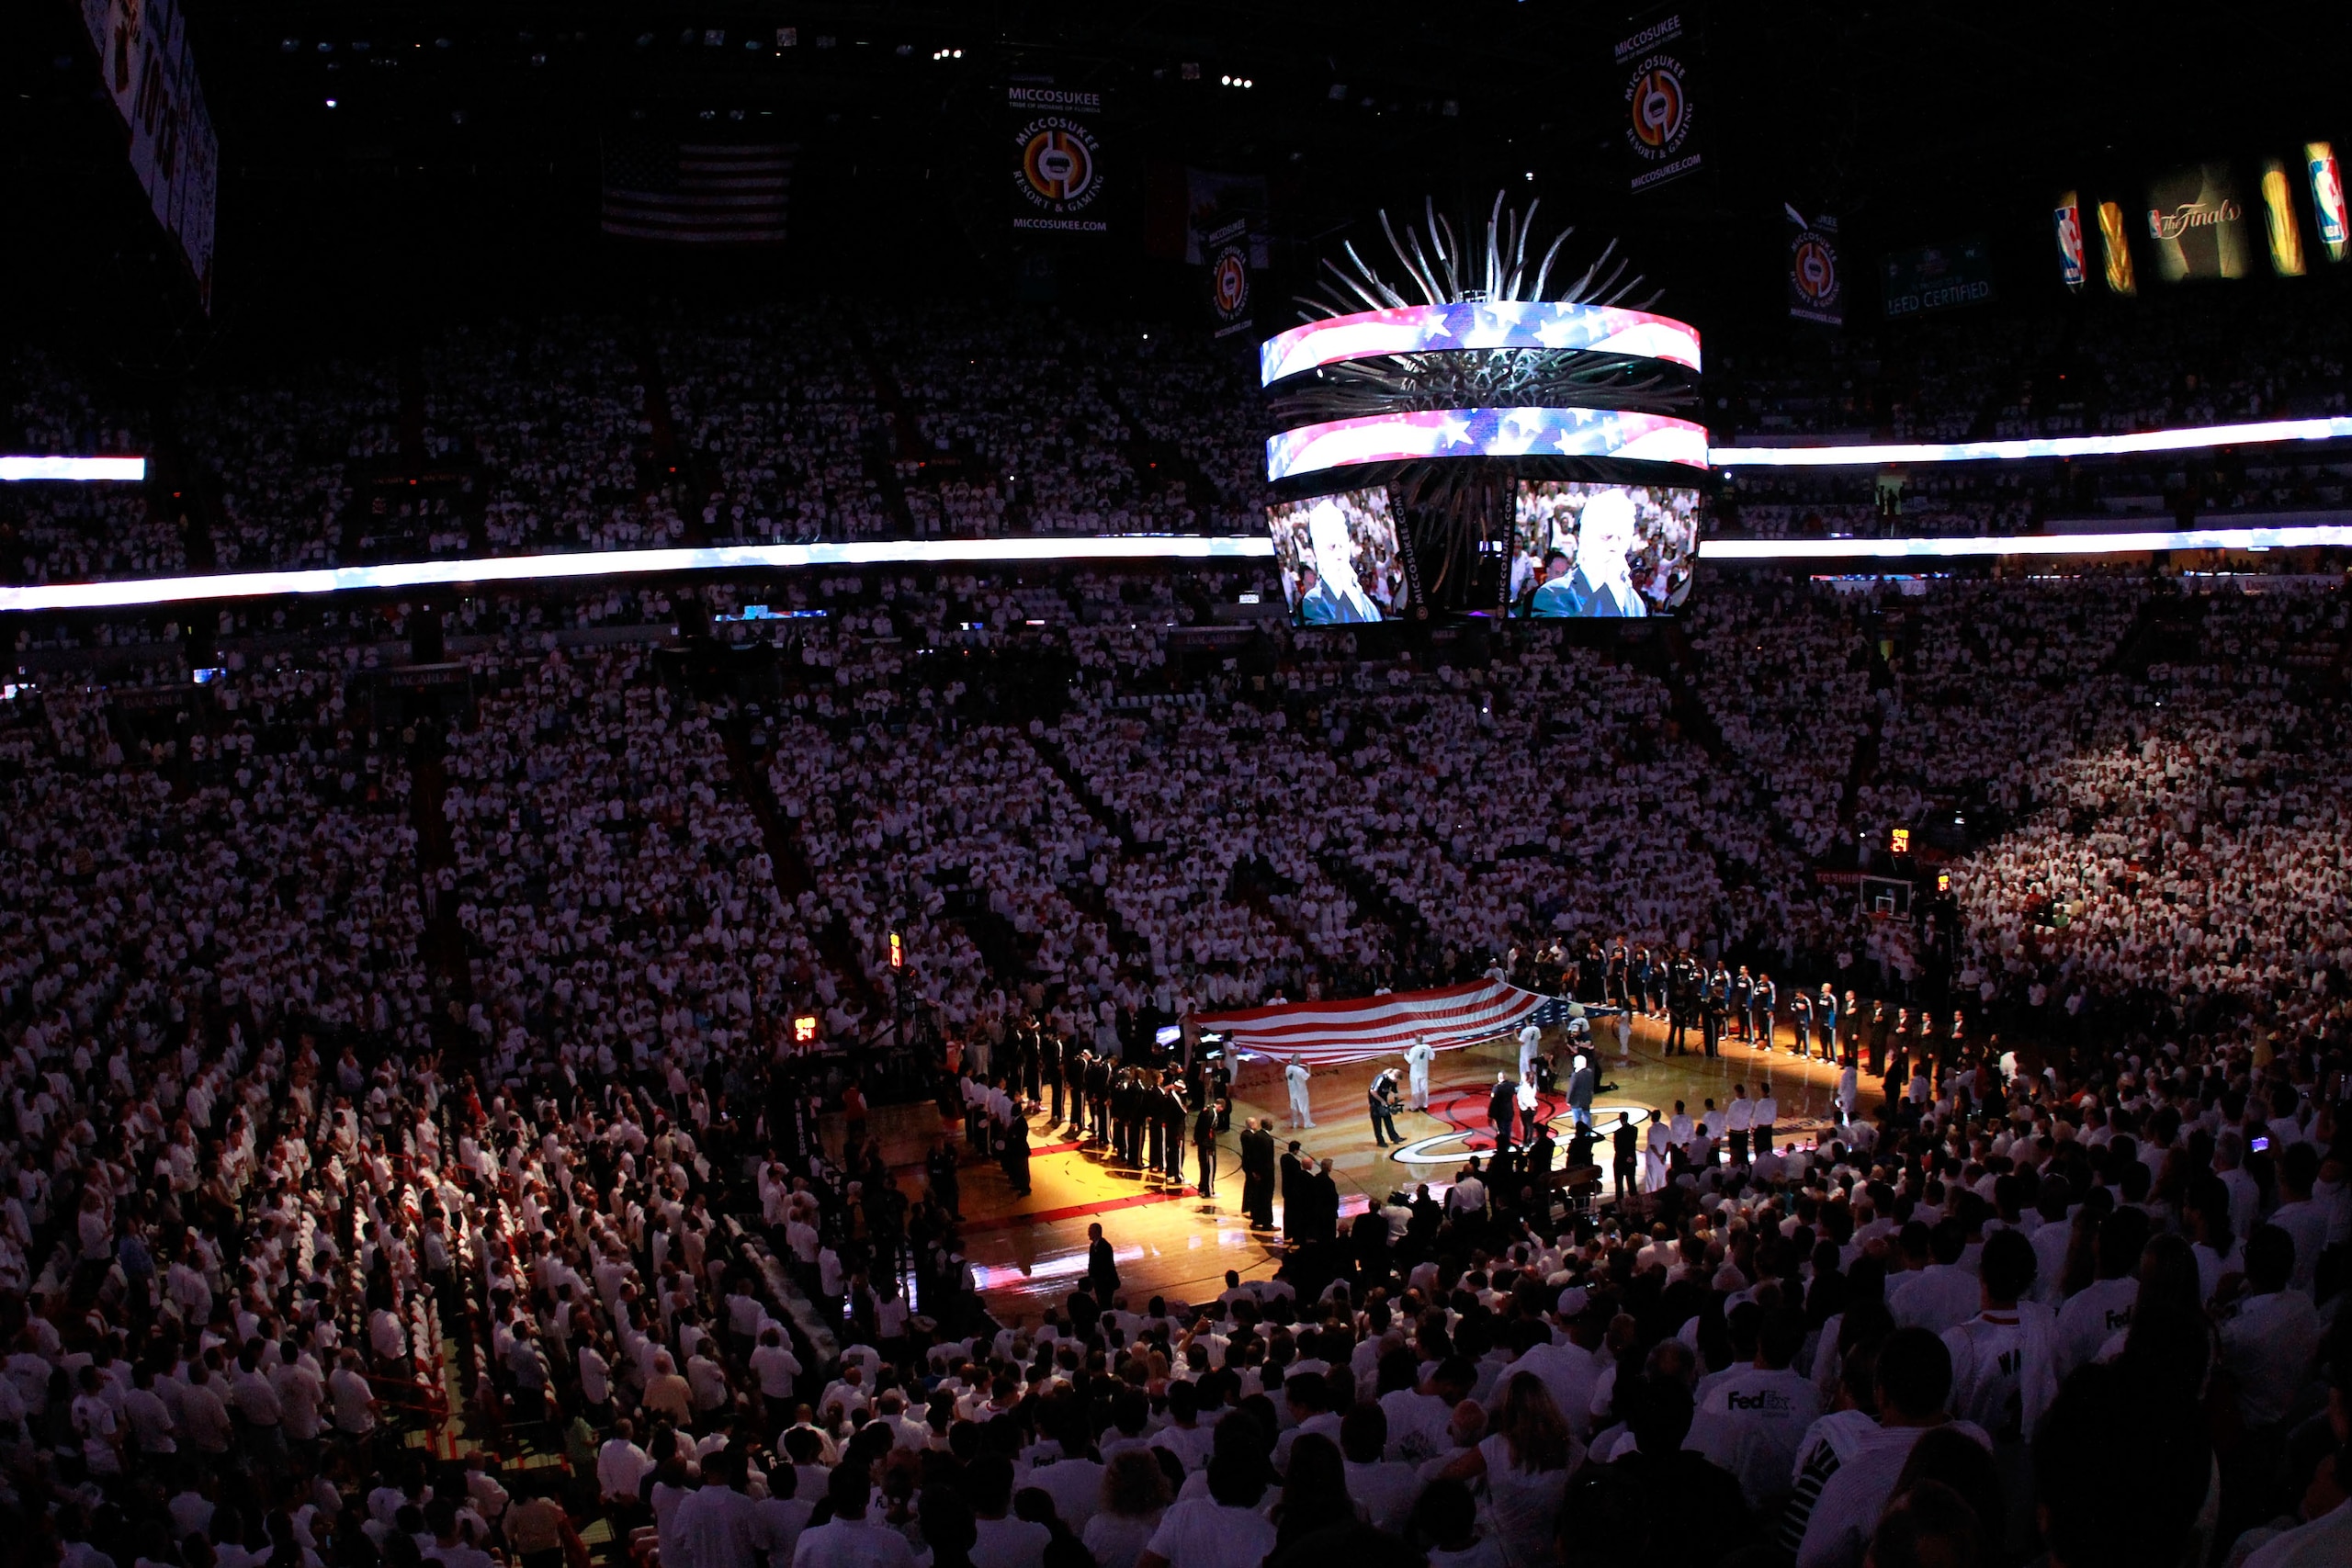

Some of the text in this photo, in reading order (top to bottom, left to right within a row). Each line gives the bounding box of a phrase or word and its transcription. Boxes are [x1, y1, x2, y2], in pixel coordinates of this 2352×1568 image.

[1613, 14, 1681, 58] MICCOSUKEE
[1009, 87, 1101, 106] MICCOSUKEE
[1624, 54, 1687, 102] MICCOSUKEE
[1015, 116, 1100, 152] MICCOSUKEE
[1625, 102, 1694, 161] RESORT & GAMING
[1631, 153, 1702, 189] MICCOSUKEE.COM
[1012, 170, 1105, 213] RESORT & GAMING
[1013, 218, 1107, 231] MICCOSUKEE.COM
[2161, 199, 2241, 237] The Finals
[1923, 279, 1989, 309] CERTIFIED
[1393, 496, 1424, 604] MICCOSUKEE.COM
[1498, 492, 1512, 603] MICCOSUKEE.COM
[1893, 838, 1907, 852] 24
[1815, 873, 1860, 883] TOSHIB
